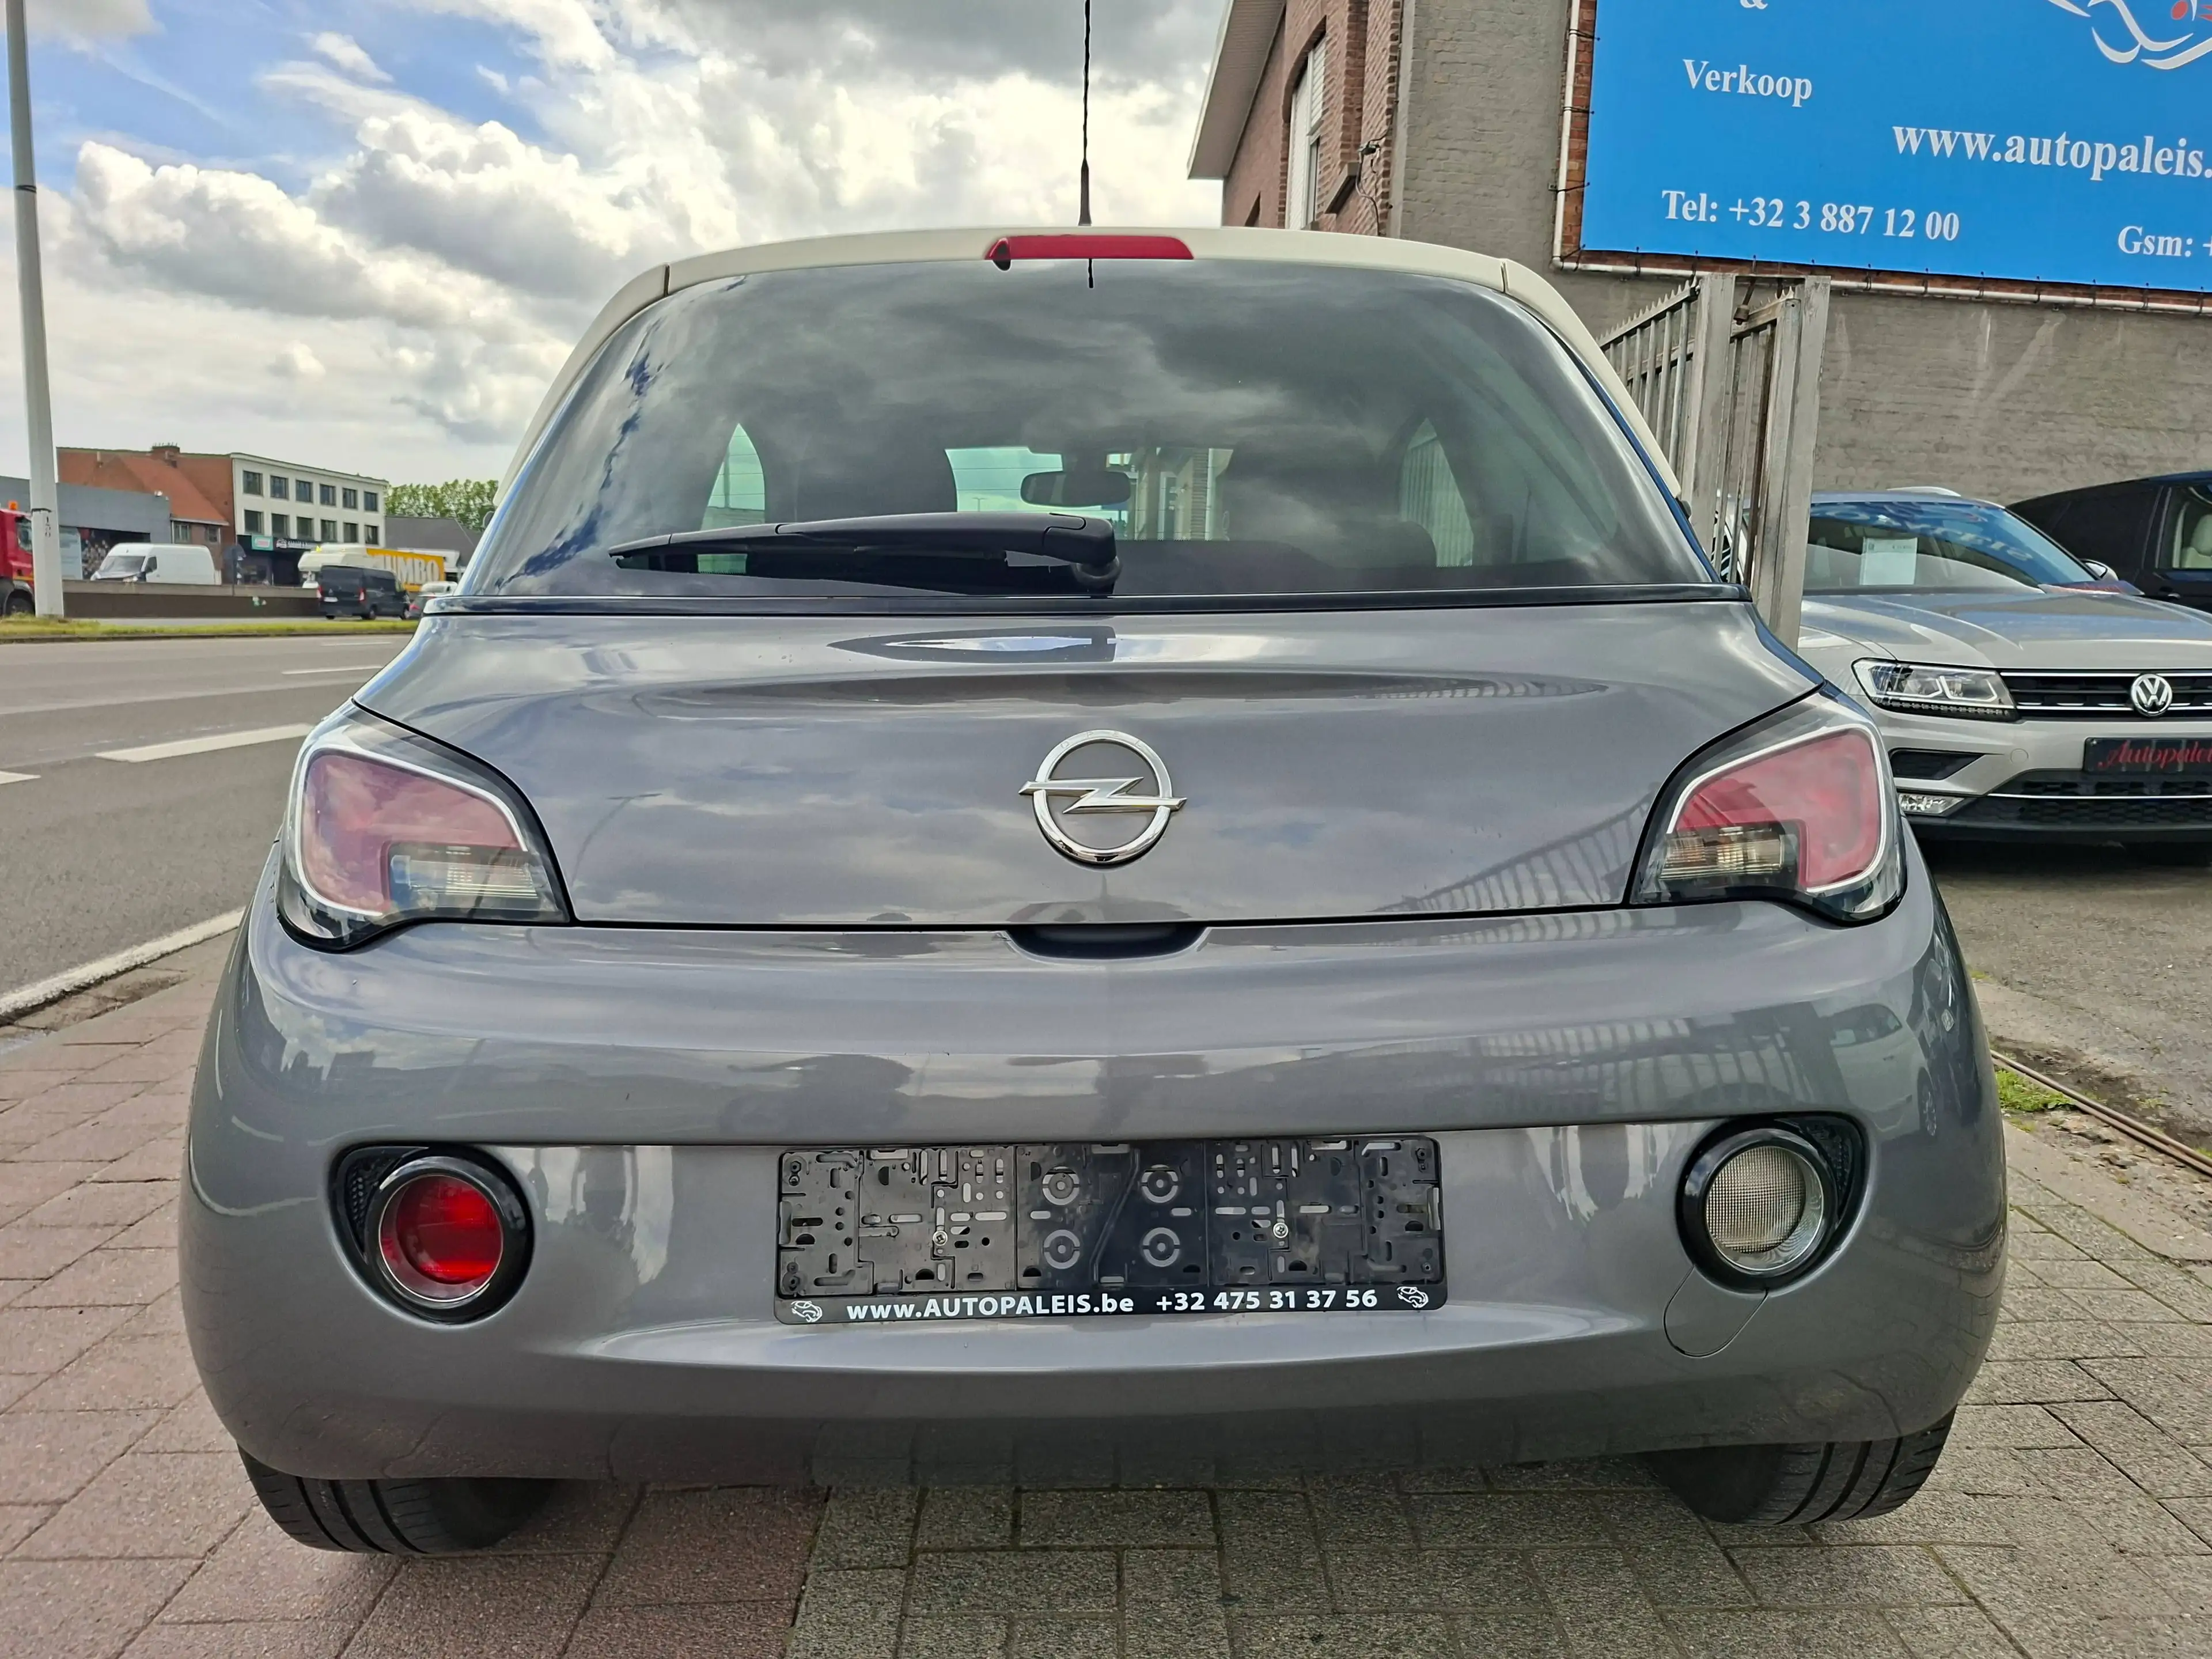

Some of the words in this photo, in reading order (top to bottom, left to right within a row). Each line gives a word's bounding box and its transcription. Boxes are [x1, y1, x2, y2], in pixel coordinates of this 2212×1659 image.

[1682, 59, 1813, 108] Verkoop
[1661, 190, 1718, 222] Tel:
[1729, 197, 1784, 228] +32
[1793, 200, 1810, 229] 3
[1820, 203, 1874, 234] 887
[1883, 208, 1915, 237] 12
[1925, 211, 1959, 241] 00
[2118, 225, 2193, 257] Gsm:
[846, 1293, 1134, 1320] www.AUTOPALEIS.be
[1156, 1292, 1205, 1311] +32
[1213, 1291, 1260, 1310] 475
[1269, 1290, 1296, 1309] 31
[1306, 1290, 1336, 1308] 37
[1346, 1289, 1378, 1308] 56
